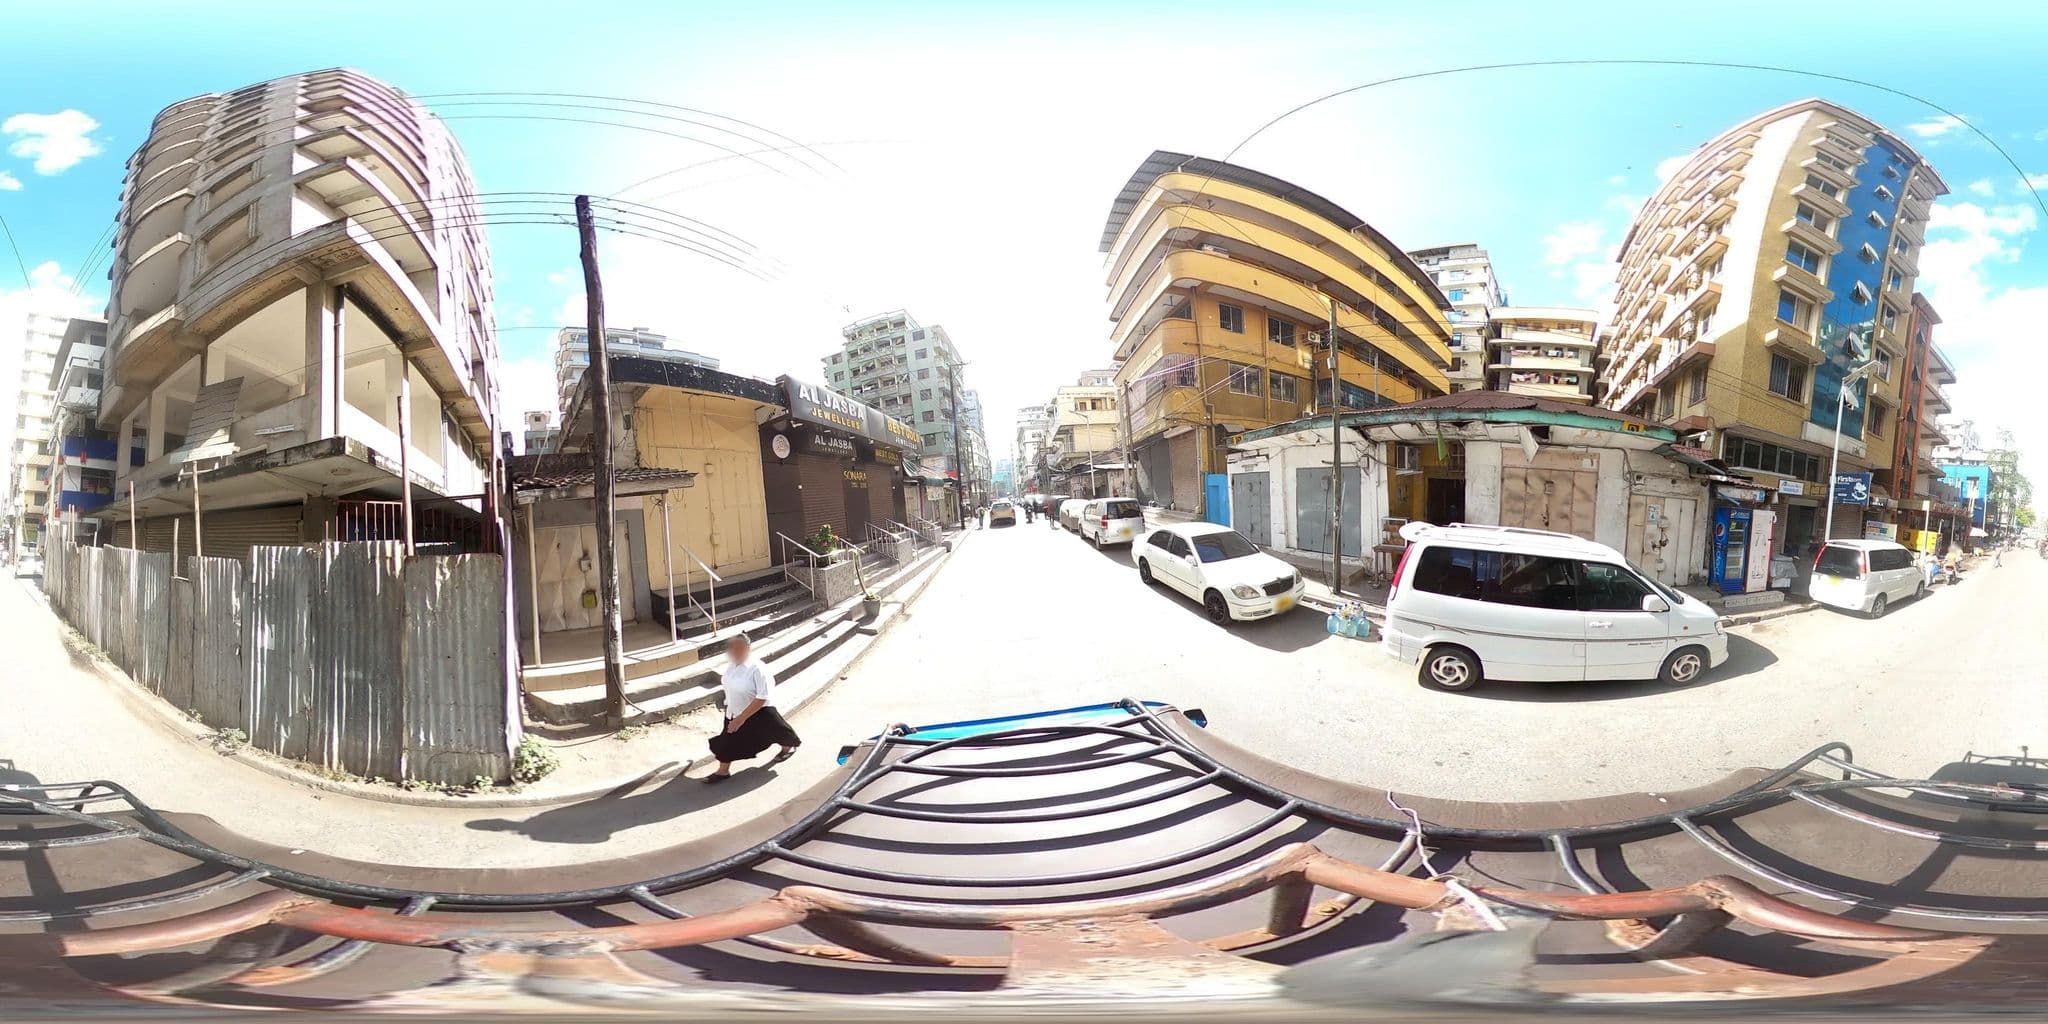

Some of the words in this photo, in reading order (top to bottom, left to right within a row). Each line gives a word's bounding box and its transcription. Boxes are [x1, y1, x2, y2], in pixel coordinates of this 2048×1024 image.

[799, 384, 820, 405] AL
[824, 393, 865, 420] JASBA
[814, 435, 827, 446] AL
[828, 438, 853, 451] JASBA
